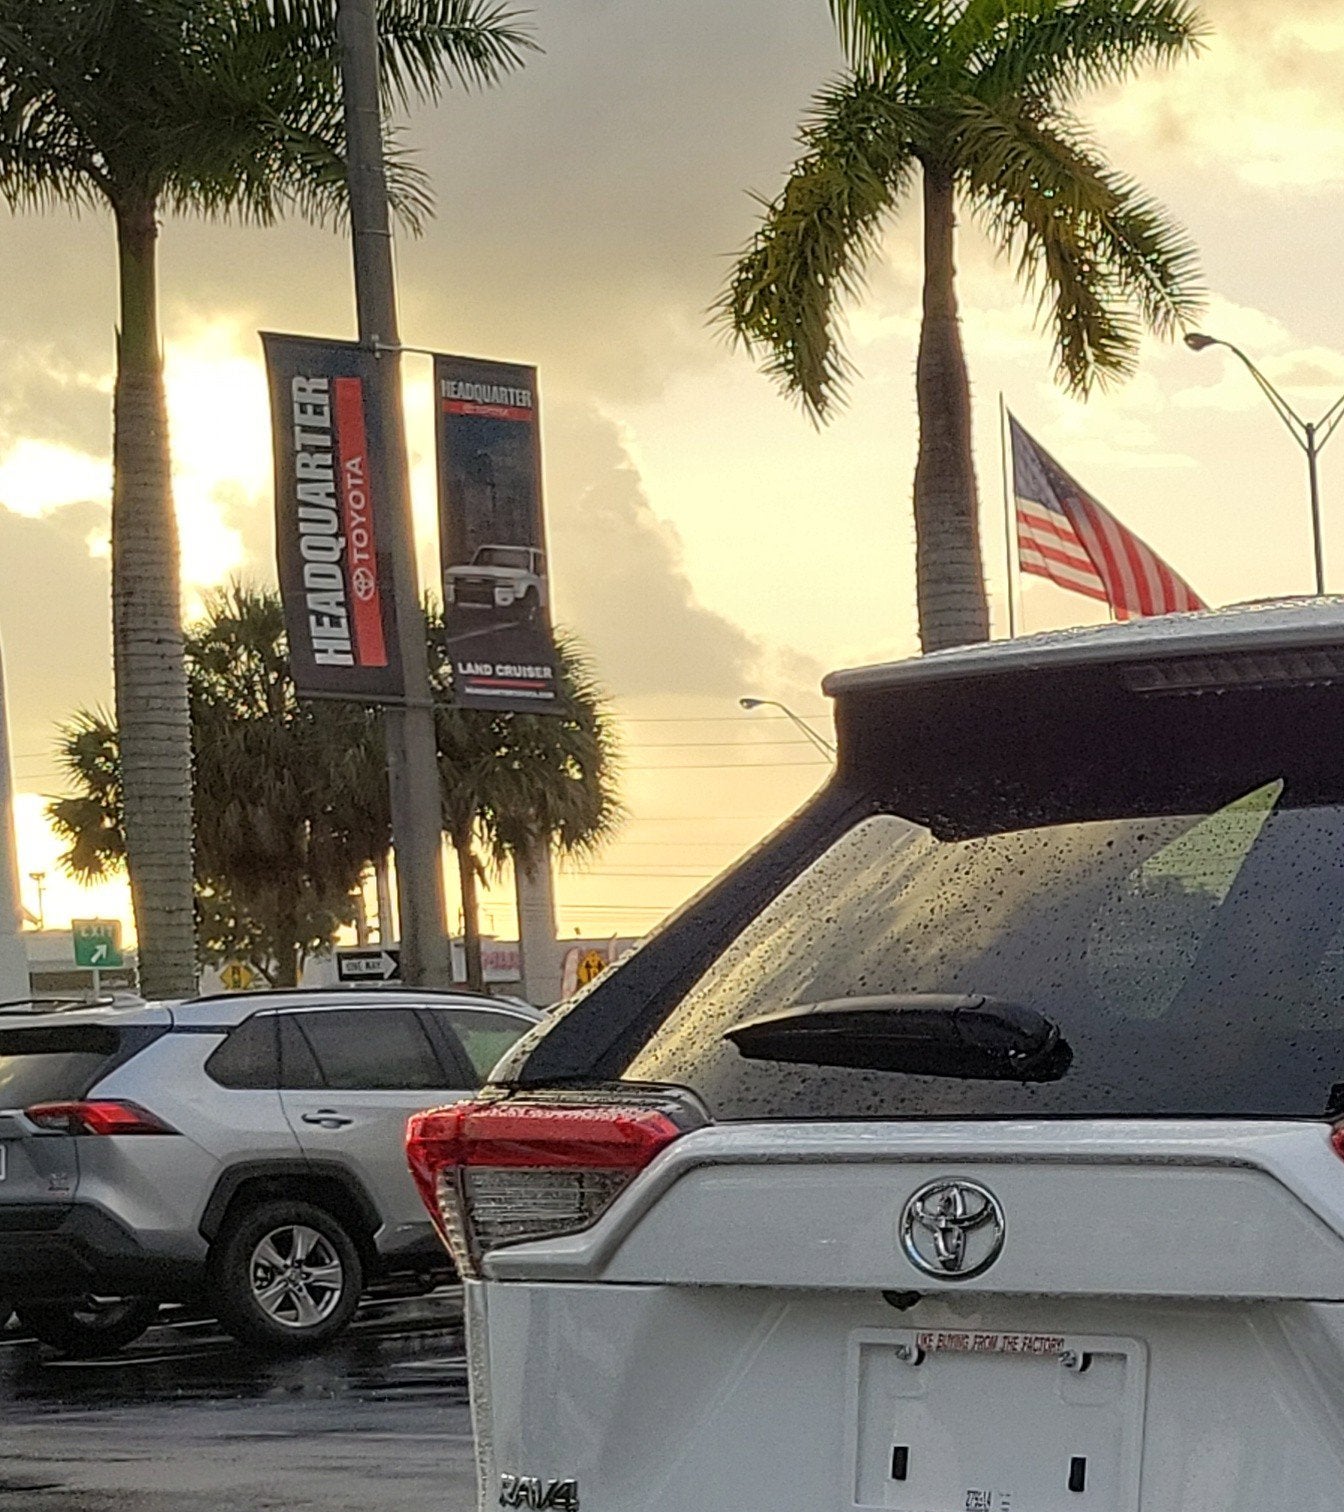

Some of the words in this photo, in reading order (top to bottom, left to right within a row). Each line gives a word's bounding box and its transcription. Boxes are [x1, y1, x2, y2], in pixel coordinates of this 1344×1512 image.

[440, 379, 533, 408] HEADQUARTER
[292, 376, 354, 667] HEADQUARTER
[345, 456, 370, 565] TOYOTA
[457, 662, 494, 676] LAND
[495, 664, 553, 679] CRUISER
